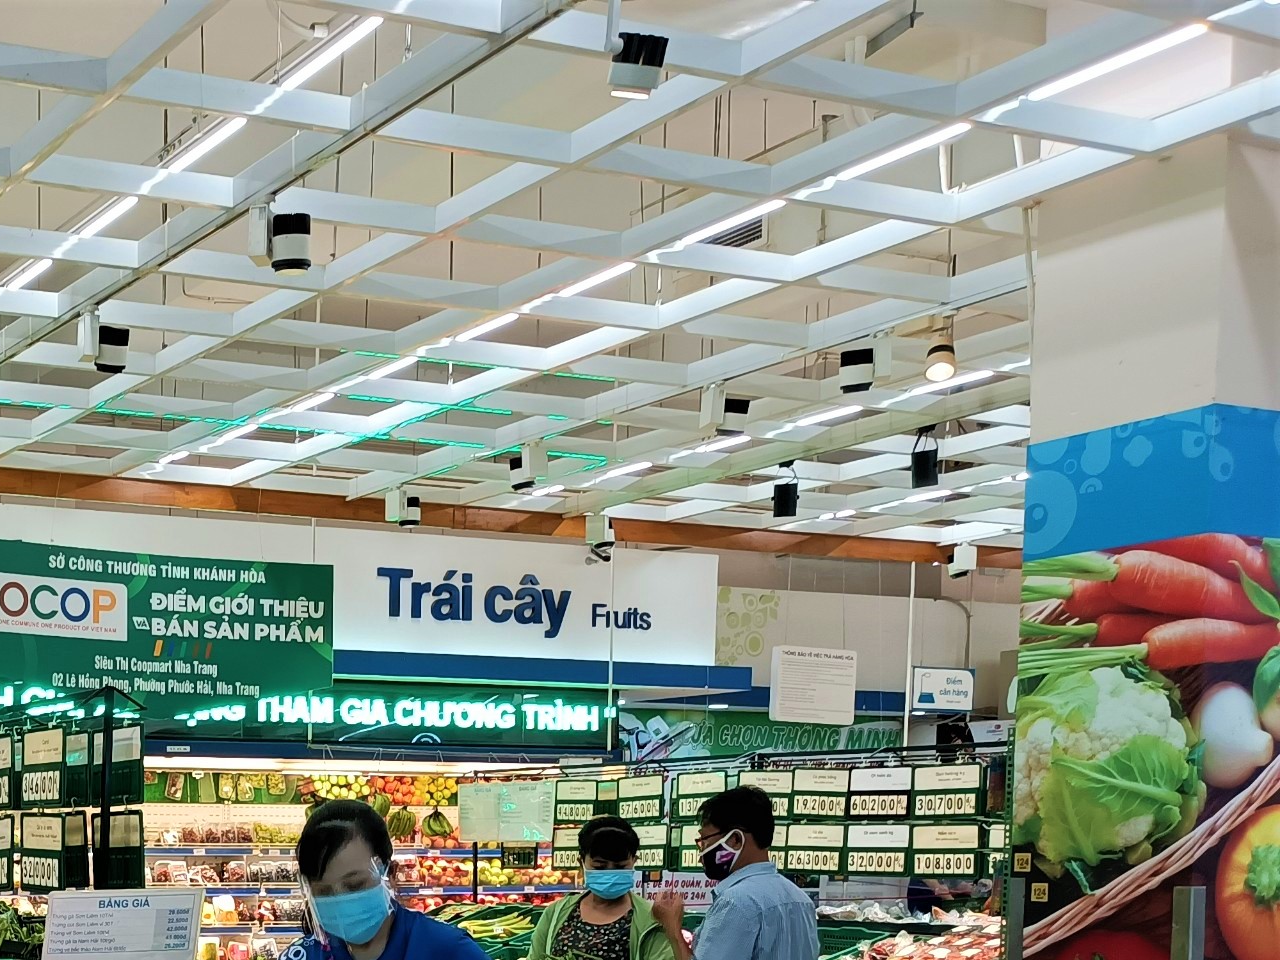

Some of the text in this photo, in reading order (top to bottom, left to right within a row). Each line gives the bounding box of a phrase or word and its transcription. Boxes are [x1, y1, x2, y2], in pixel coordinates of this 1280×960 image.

[48, 551, 267, 584] SỞ CÔNG THƯƠNG TỈNH KHÁNH HÒA
[149, 587, 206, 614] ĐIỂM
[208, 592, 255, 616] GIỚI
[376, 566, 652, 639] Trái cây Fruits
[11, 619, 40, 628] COMMUNE
[53, 622, 81, 631] PRODUCT
[135, 618, 148, 628] VÀ
[151, 613, 325, 644] BÁN SẢN PHẨM
[94, 655, 218, 678] Siêu Thị Coopmart Nha Trang
[51, 672, 64, 687] 02
[65, 673, 76, 688] Lê
[133, 677, 166, 696] Phường
[167, 679, 195, 694] Phước
[216, 681, 233, 696] Nha
[235, 681, 260, 699] Trang
[339, 697, 390, 726] GIA
[393, 700, 517, 730] CHƯƠNG
[521, 698, 600, 732] TRÌNH
[719, 724, 771, 751] CHỌN
[771, 722, 843, 751] THÔNG
[1016, 857, 1030, 866] 124
[98, 896, 151, 909] BẢNG GIÁ
[1033, 888, 1047, 897] 124
